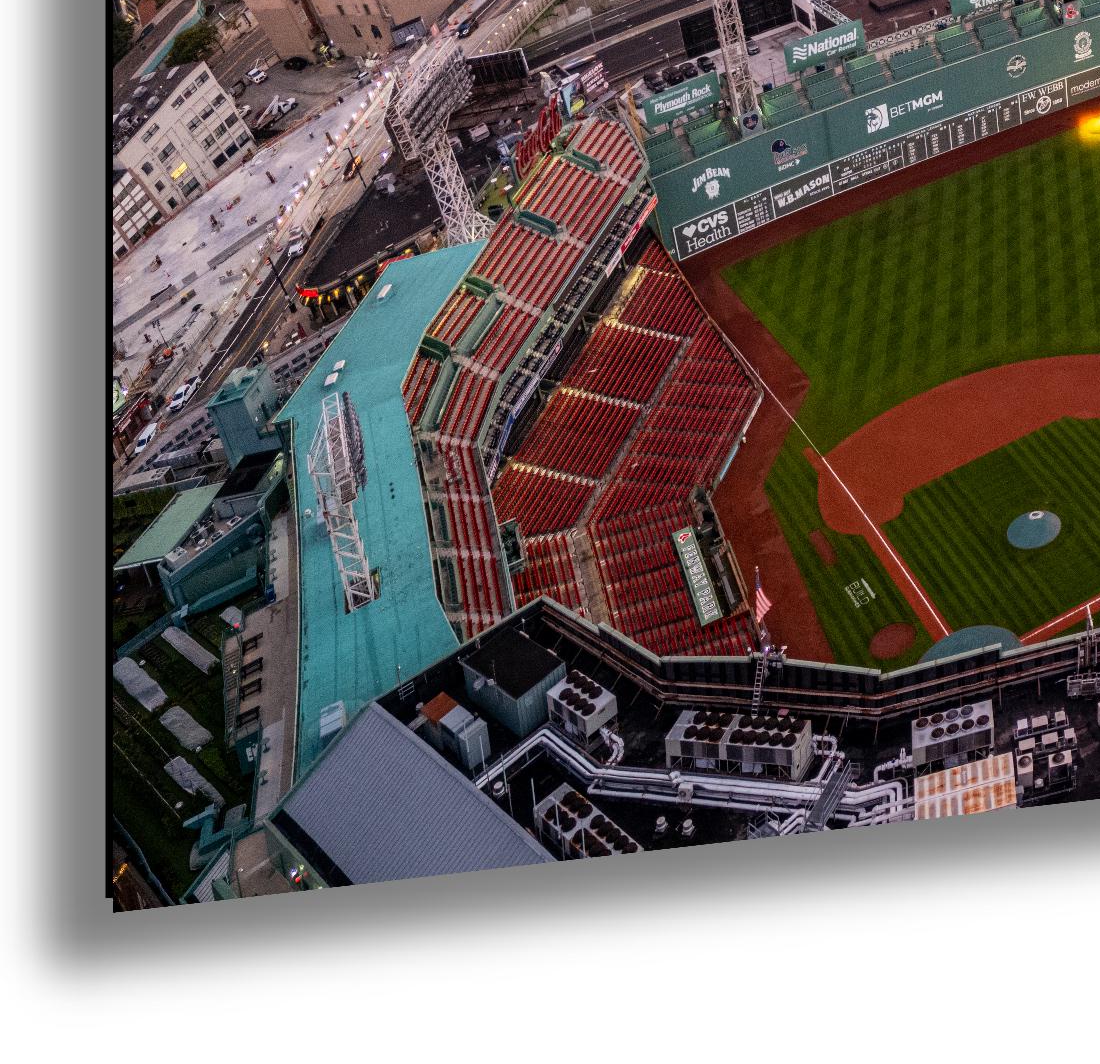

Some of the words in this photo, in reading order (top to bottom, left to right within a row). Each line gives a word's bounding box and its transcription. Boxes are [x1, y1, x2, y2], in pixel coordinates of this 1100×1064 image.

[808, 28, 857, 56] National
[838, 41, 857, 53] Rental
[654, 91, 691, 115] Plymouth
[691, 83, 711, 100] Rock
[1039, 82, 1064, 97] WEBB
[890, 90, 943, 118] BETMGM
[692, 173, 707, 192] JIM
[706, 167, 731, 180] BEAM
[697, 211, 729, 233] CVS
[686, 225, 732, 253] Health
[682, 543, 708, 588] FENWAY
[697, 587, 719, 620] PARK
[850, 581, 869, 605] BUILD
